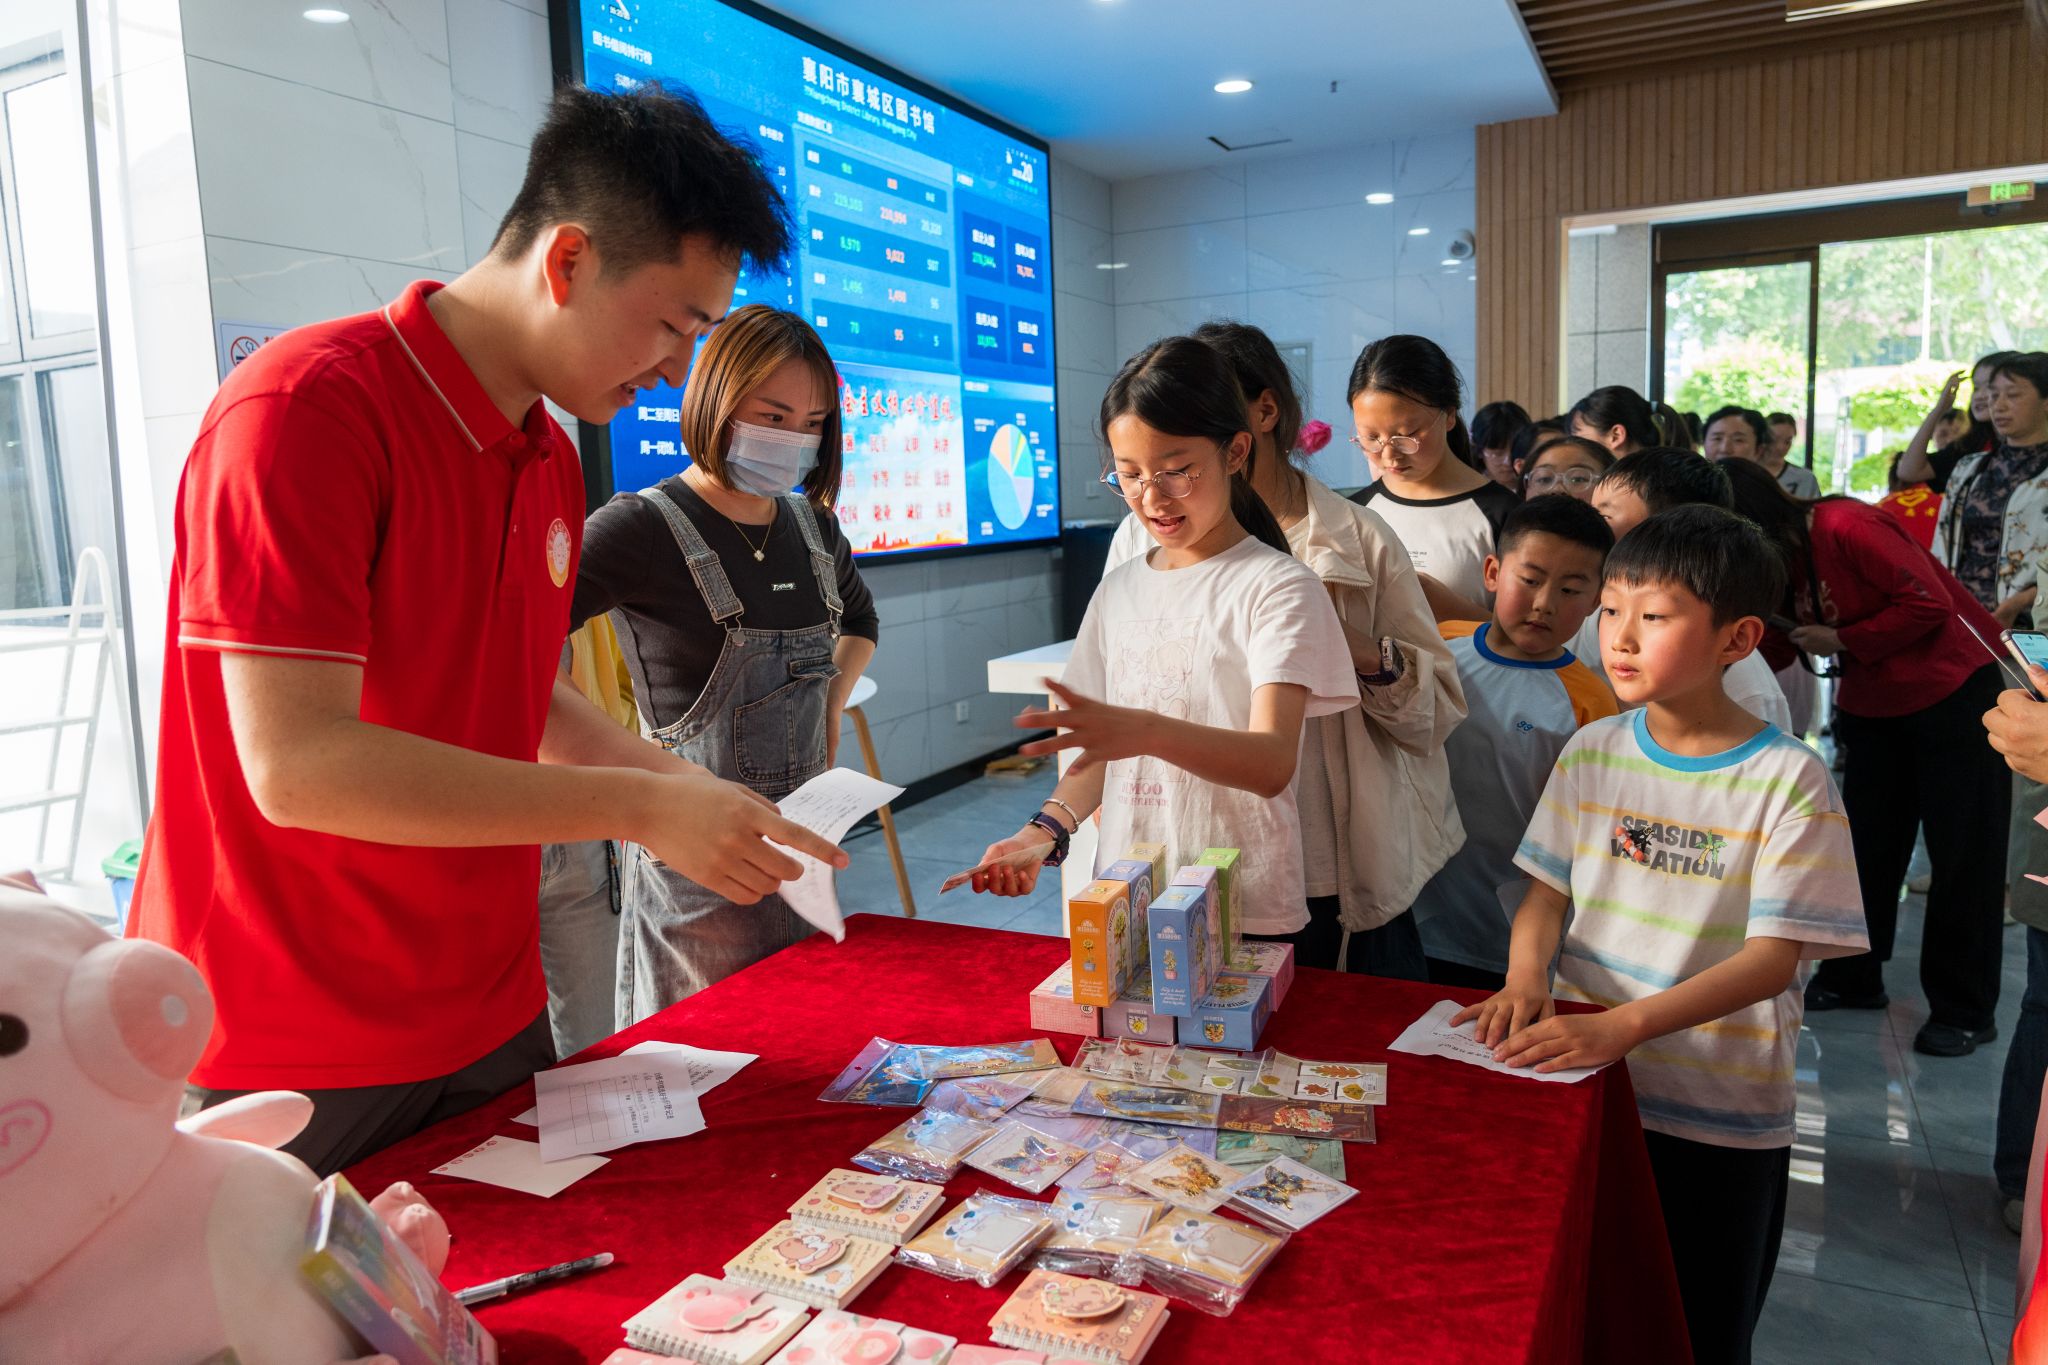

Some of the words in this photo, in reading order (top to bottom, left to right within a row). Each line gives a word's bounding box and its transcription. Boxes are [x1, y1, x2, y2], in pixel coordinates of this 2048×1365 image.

[802, 56, 935, 135] 襄阳市襄城区图书馆
[1611, 838, 1726, 881] VCATION
